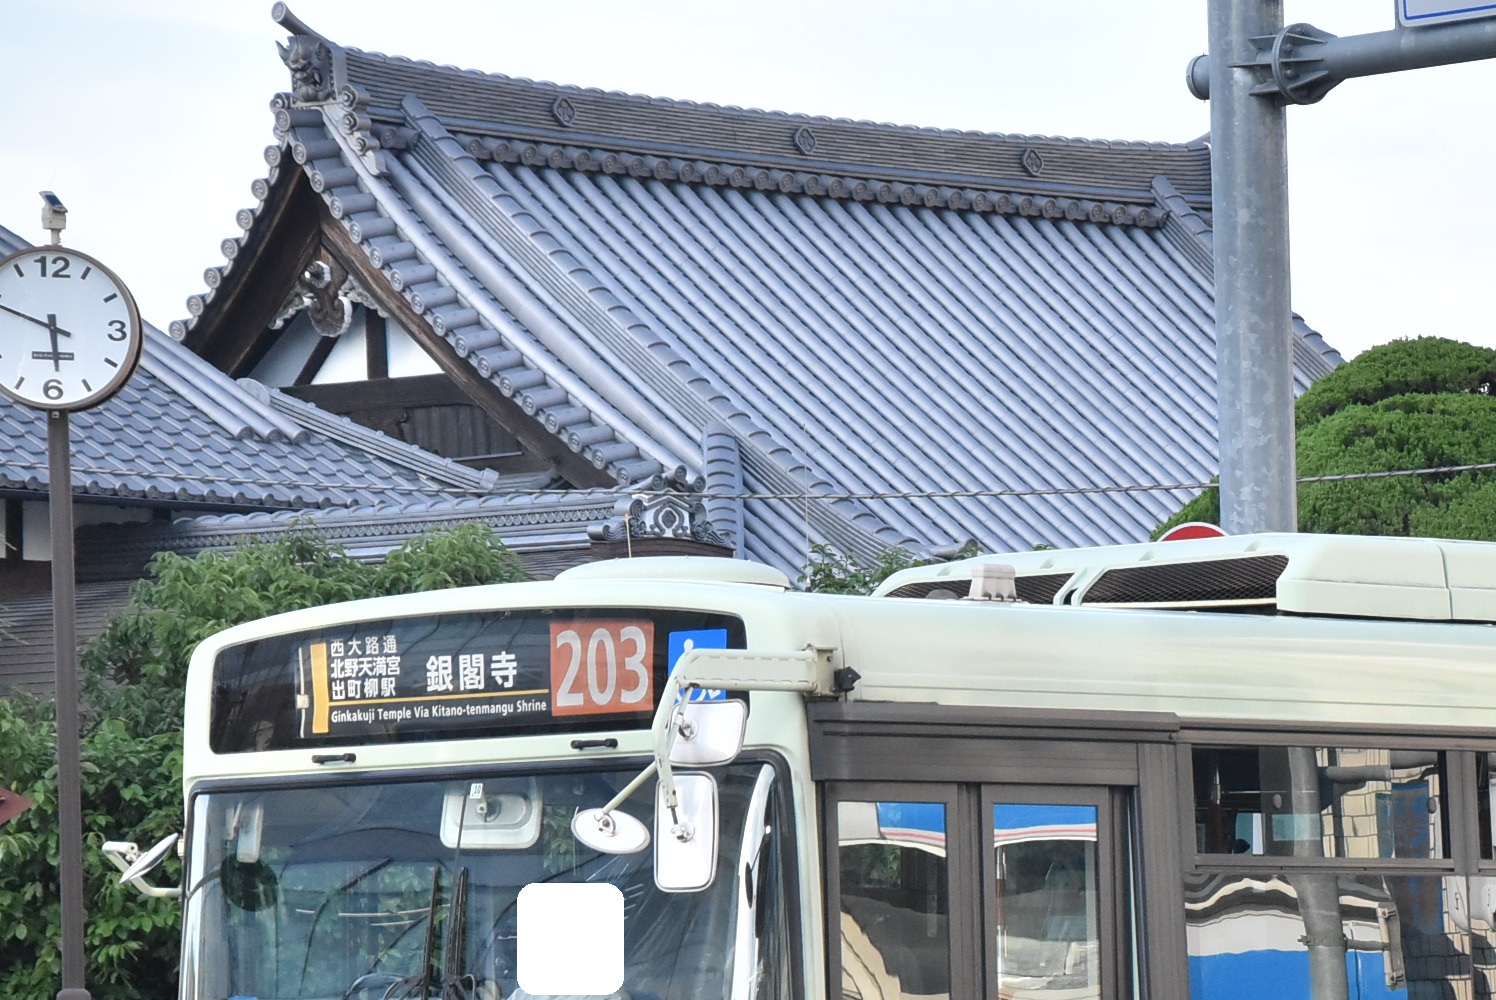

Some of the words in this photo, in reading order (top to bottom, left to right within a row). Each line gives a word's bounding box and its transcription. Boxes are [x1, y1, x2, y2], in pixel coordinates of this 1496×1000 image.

[33, 256, 71, 278] 12
[107, 320, 127, 342] 3
[42, 379, 64, 400] 6
[330, 635, 397, 657] 西大路通
[330, 656, 401, 679] 北野天満宮
[426, 650, 518, 692] 銀閣寺
[556, 625, 649, 707] 203
[331, 677, 396, 700] 出町柳駅
[331, 708, 375, 724] Ginkakuji
[378, 706, 412, 723] Temple
[414, 705, 430, 718] Via
[431, 702, 514, 718] Kitano-tenmangu
[516, 700, 547, 713] Shrine
